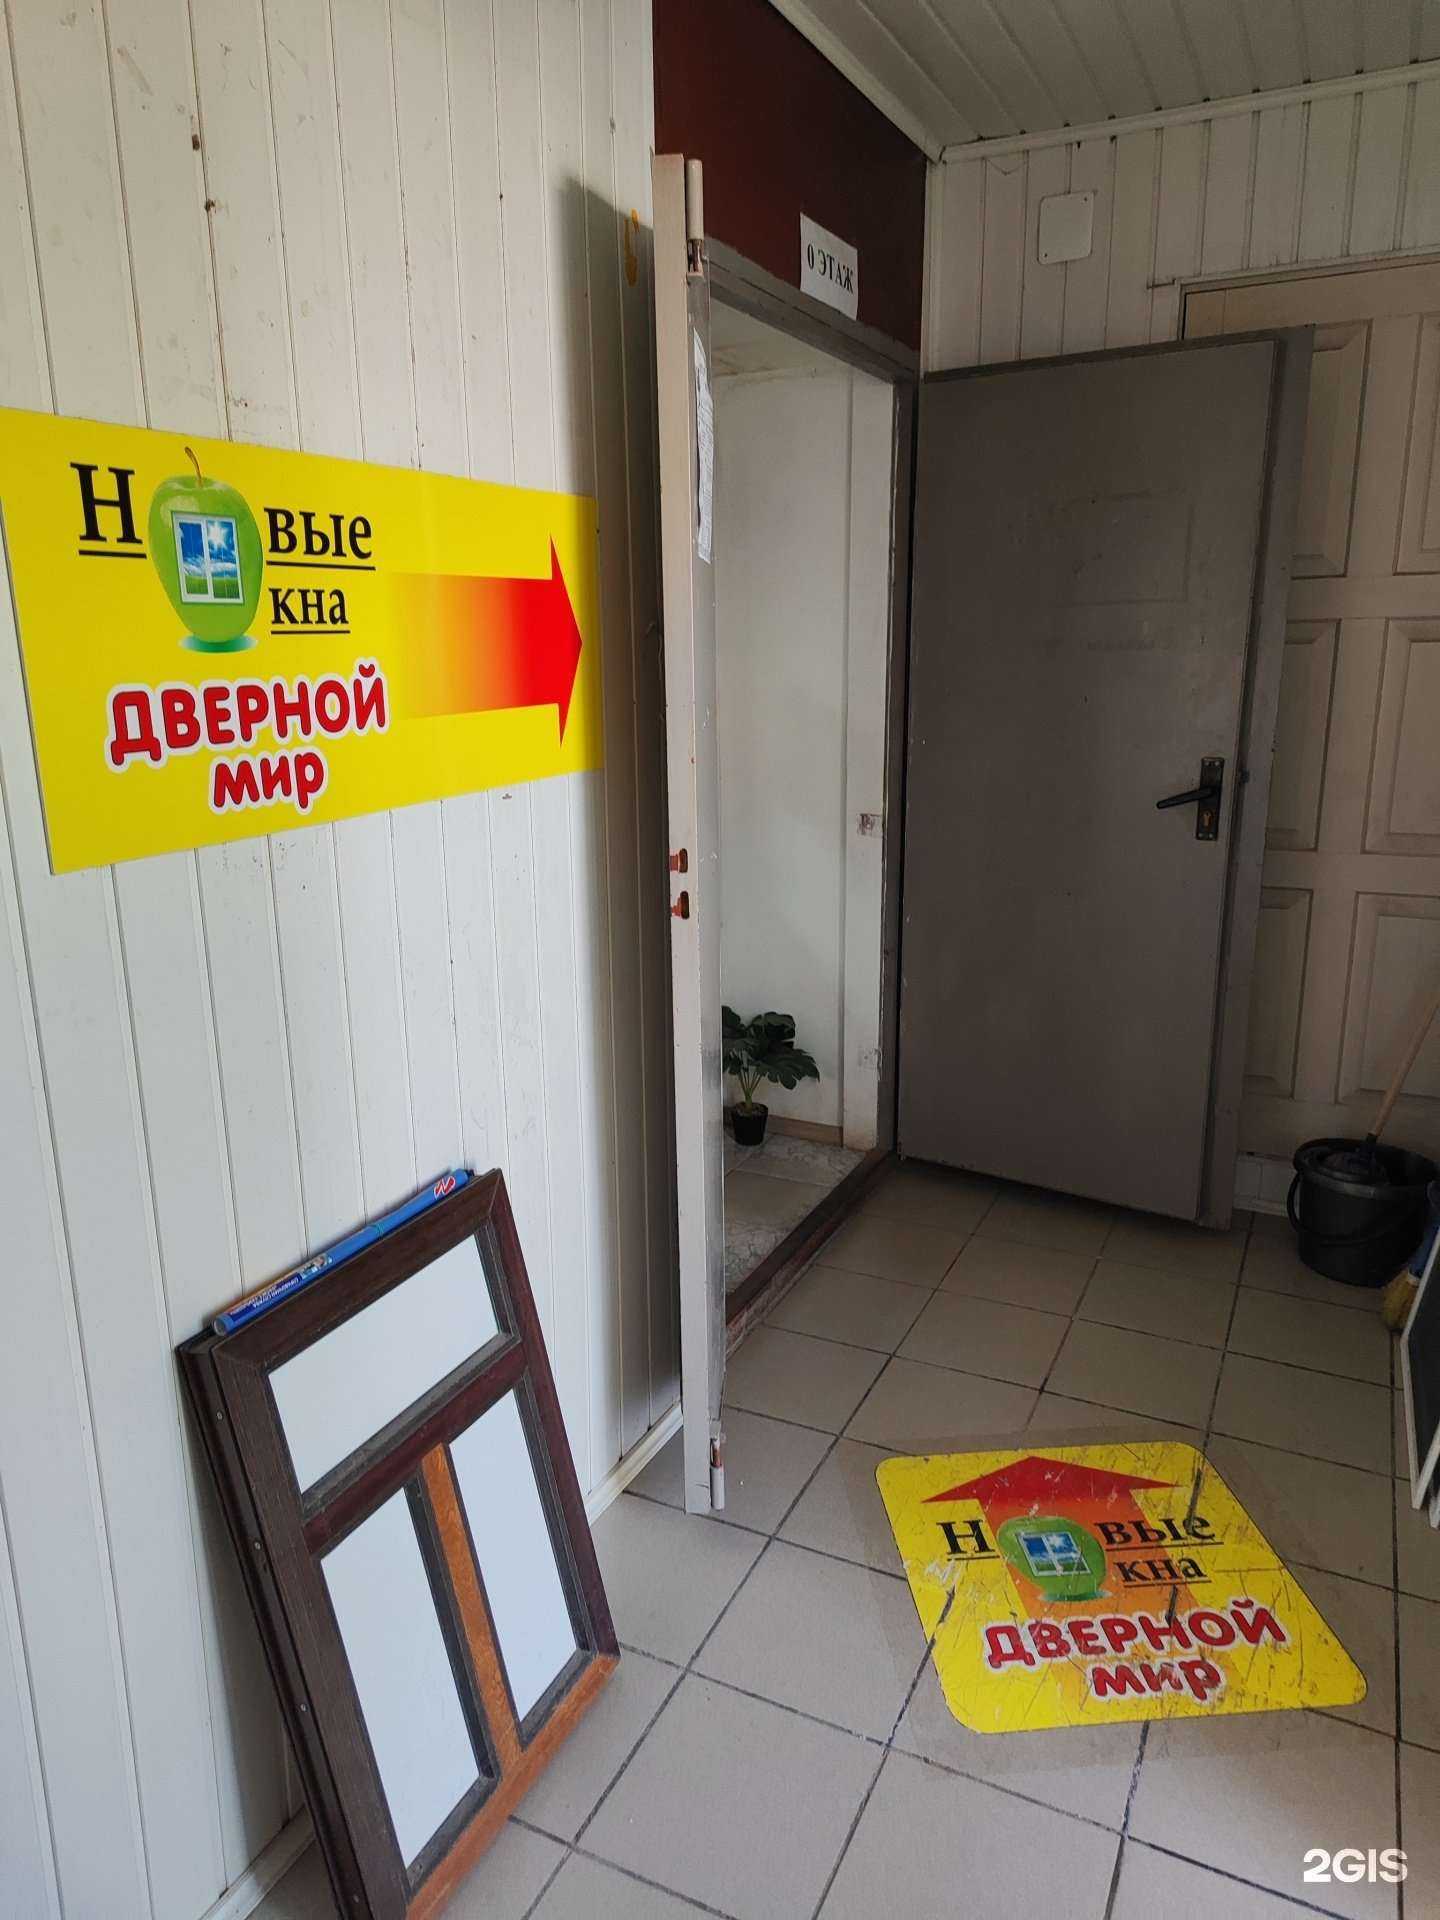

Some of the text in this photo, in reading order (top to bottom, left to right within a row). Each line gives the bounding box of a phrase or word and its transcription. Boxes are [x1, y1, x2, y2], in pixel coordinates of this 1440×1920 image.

[817, 248, 854, 294] ЭТАЖ
[109, 663, 387, 766] ДВЕРНОЙ
[985, 1599, 1287, 1668] ДВЕРНОЙ
